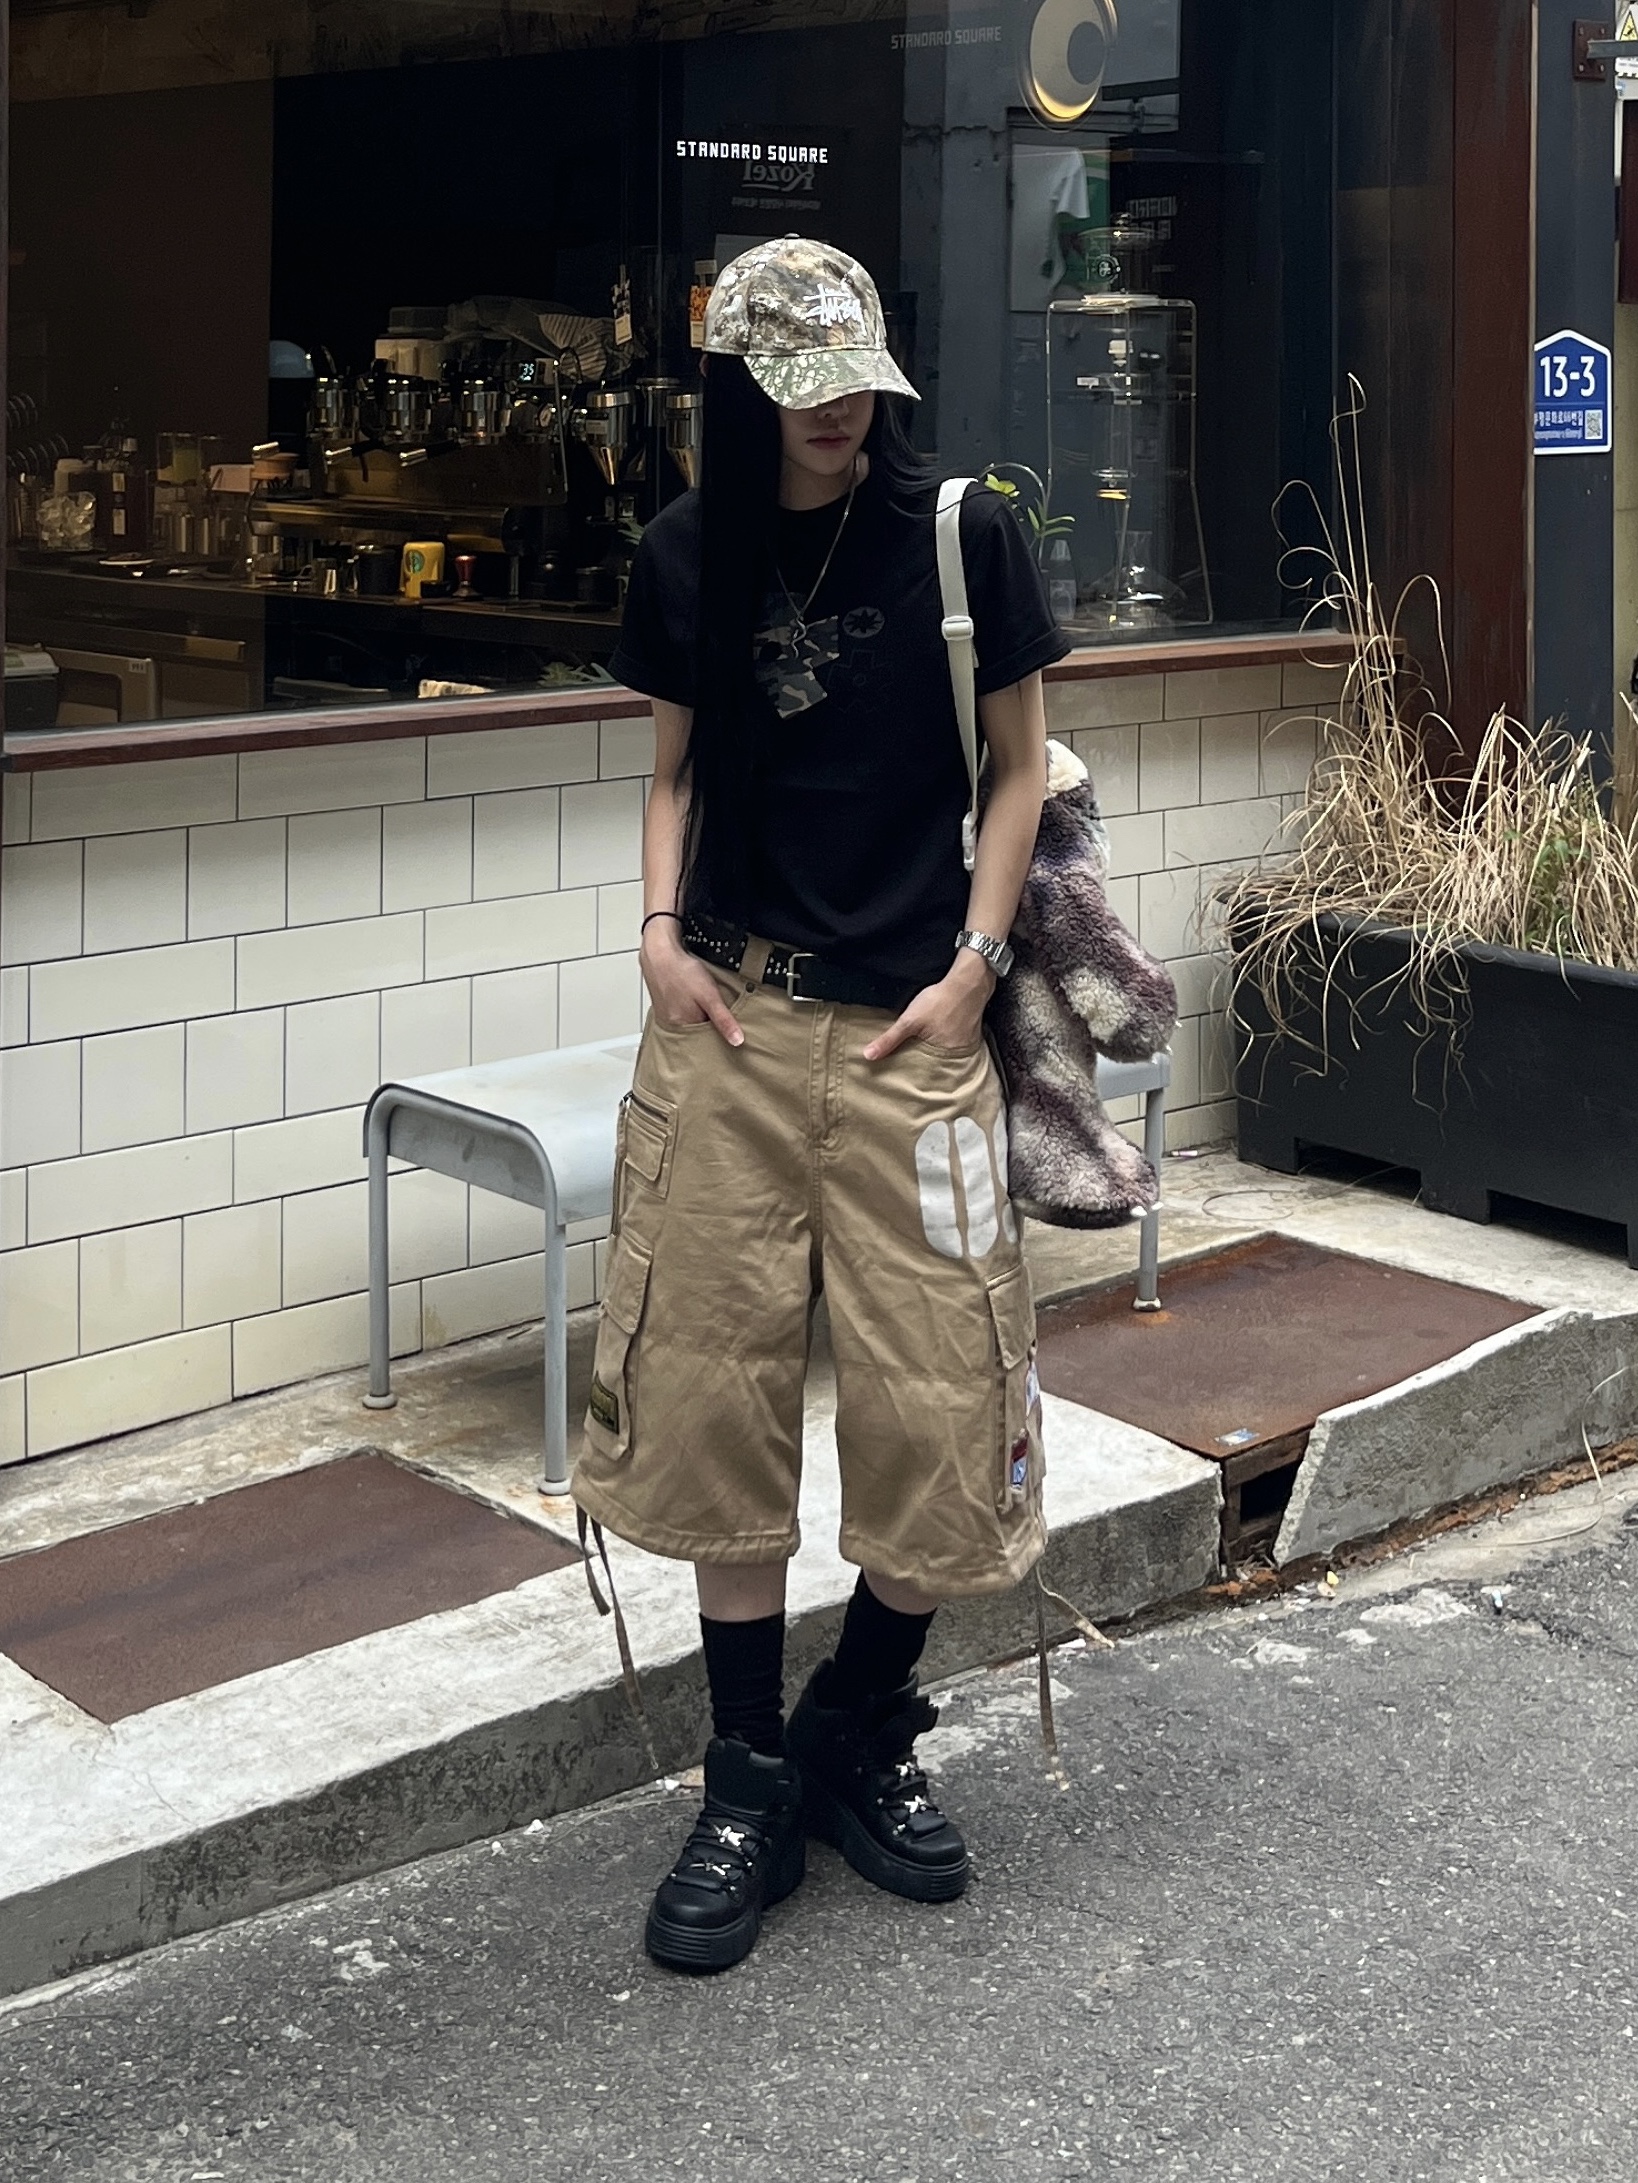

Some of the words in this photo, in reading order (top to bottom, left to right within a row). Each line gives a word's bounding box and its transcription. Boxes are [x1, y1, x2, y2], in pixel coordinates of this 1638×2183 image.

[891, 30, 952, 50] STANDARD
[954, 26, 1002, 45] SQUARE
[677, 140, 762, 161] STANDARD
[768, 145, 828, 164] SQUARE
[1540, 355, 1596, 397] 13-3
